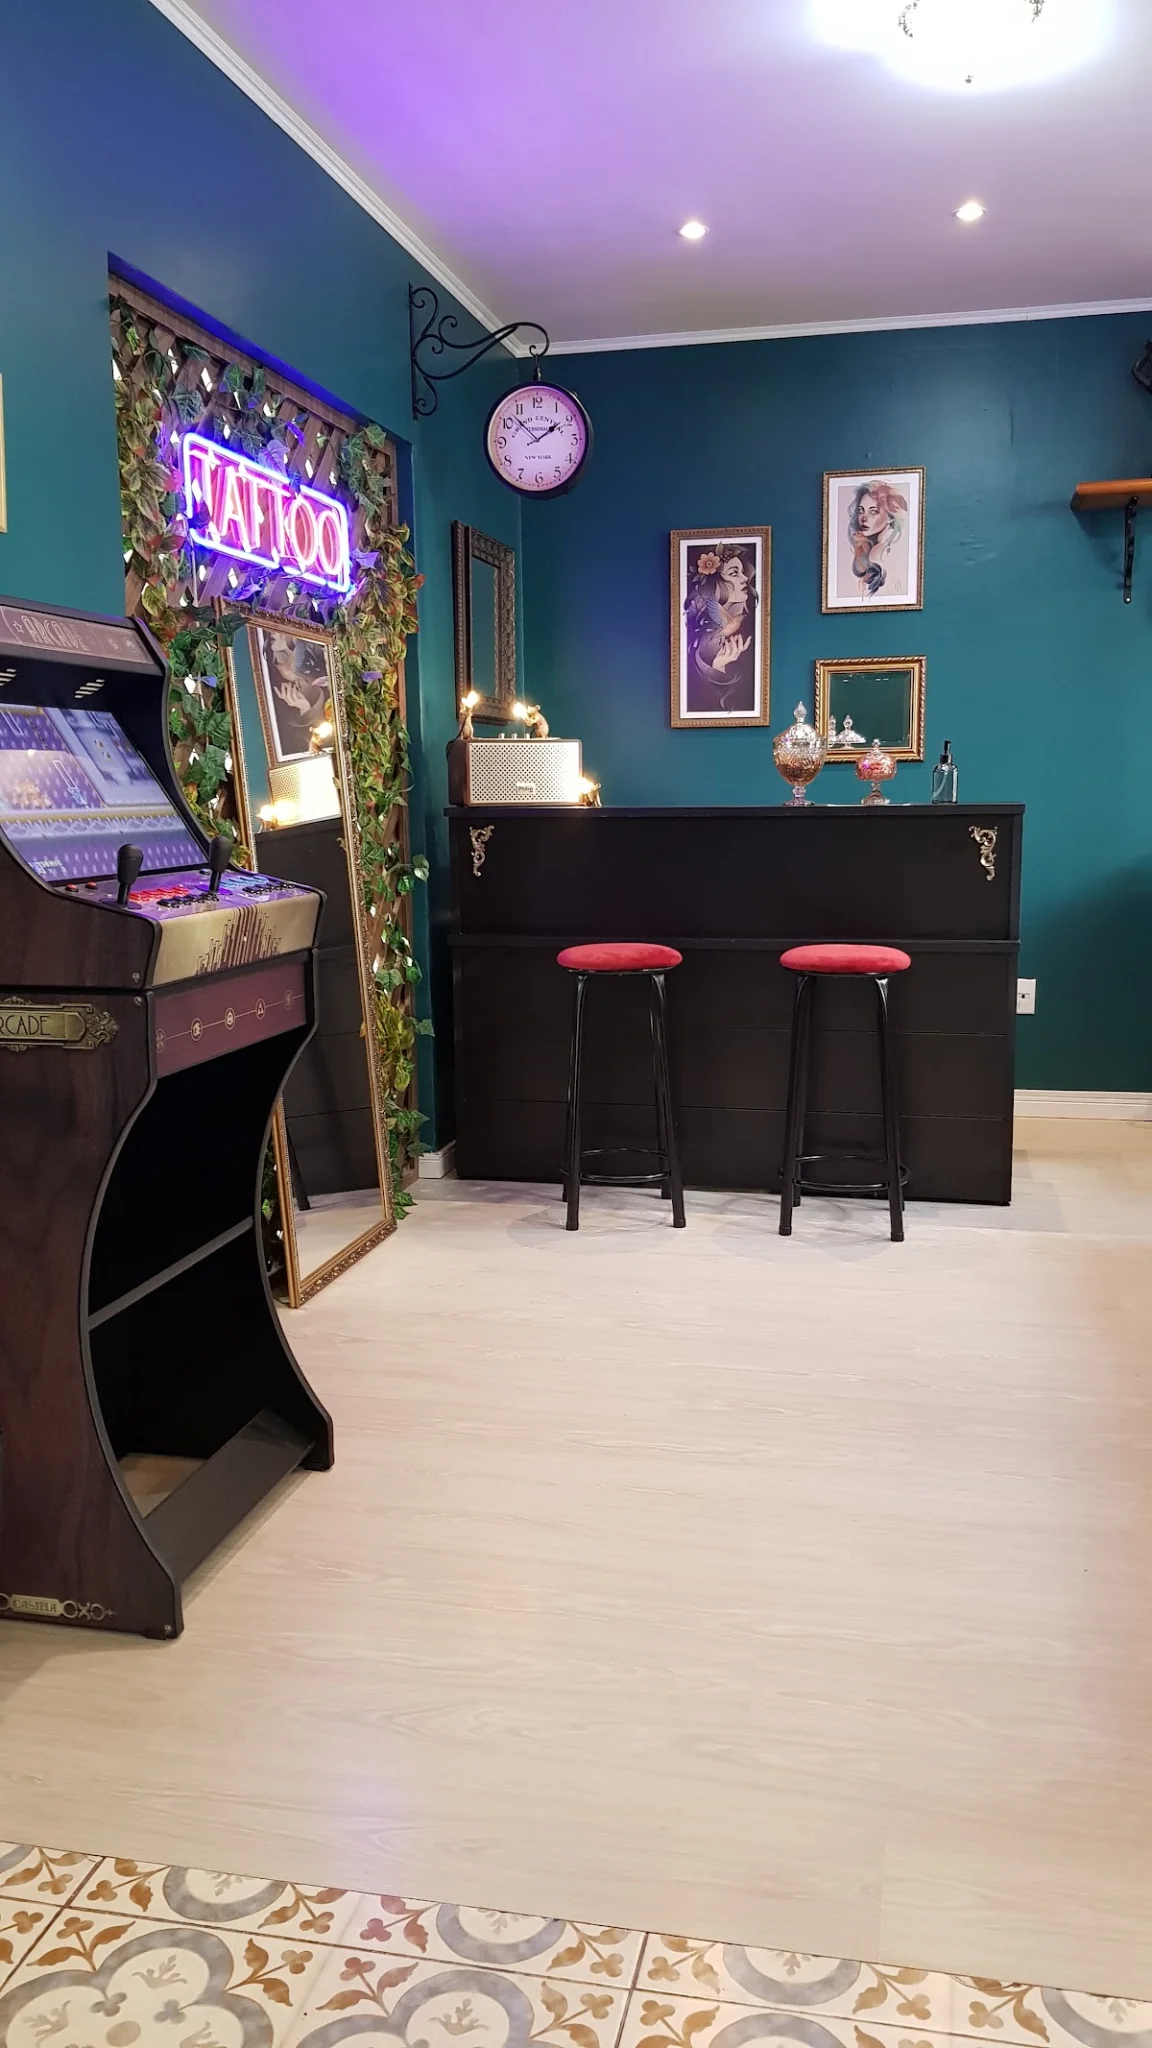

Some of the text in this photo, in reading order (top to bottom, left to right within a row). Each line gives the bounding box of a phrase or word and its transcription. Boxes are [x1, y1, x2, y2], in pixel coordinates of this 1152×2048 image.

[532, 397, 543, 408] 12
[516, 403, 523, 415] 11
[503, 417, 514, 429] 10
[565, 415, 573, 426] 2
[512, 417, 533, 438] GRND
[497, 437, 507, 449] 9
[571, 434, 579, 446] 3
[504, 455, 512, 467] 8
[565, 453, 574, 464] 4
[517, 468, 524, 480] 7
[535, 472, 544, 484] 6
[554, 466, 562, 478] 5
[190, 449, 343, 575] TATTOO
[21, 615, 91, 650] ARCADE
